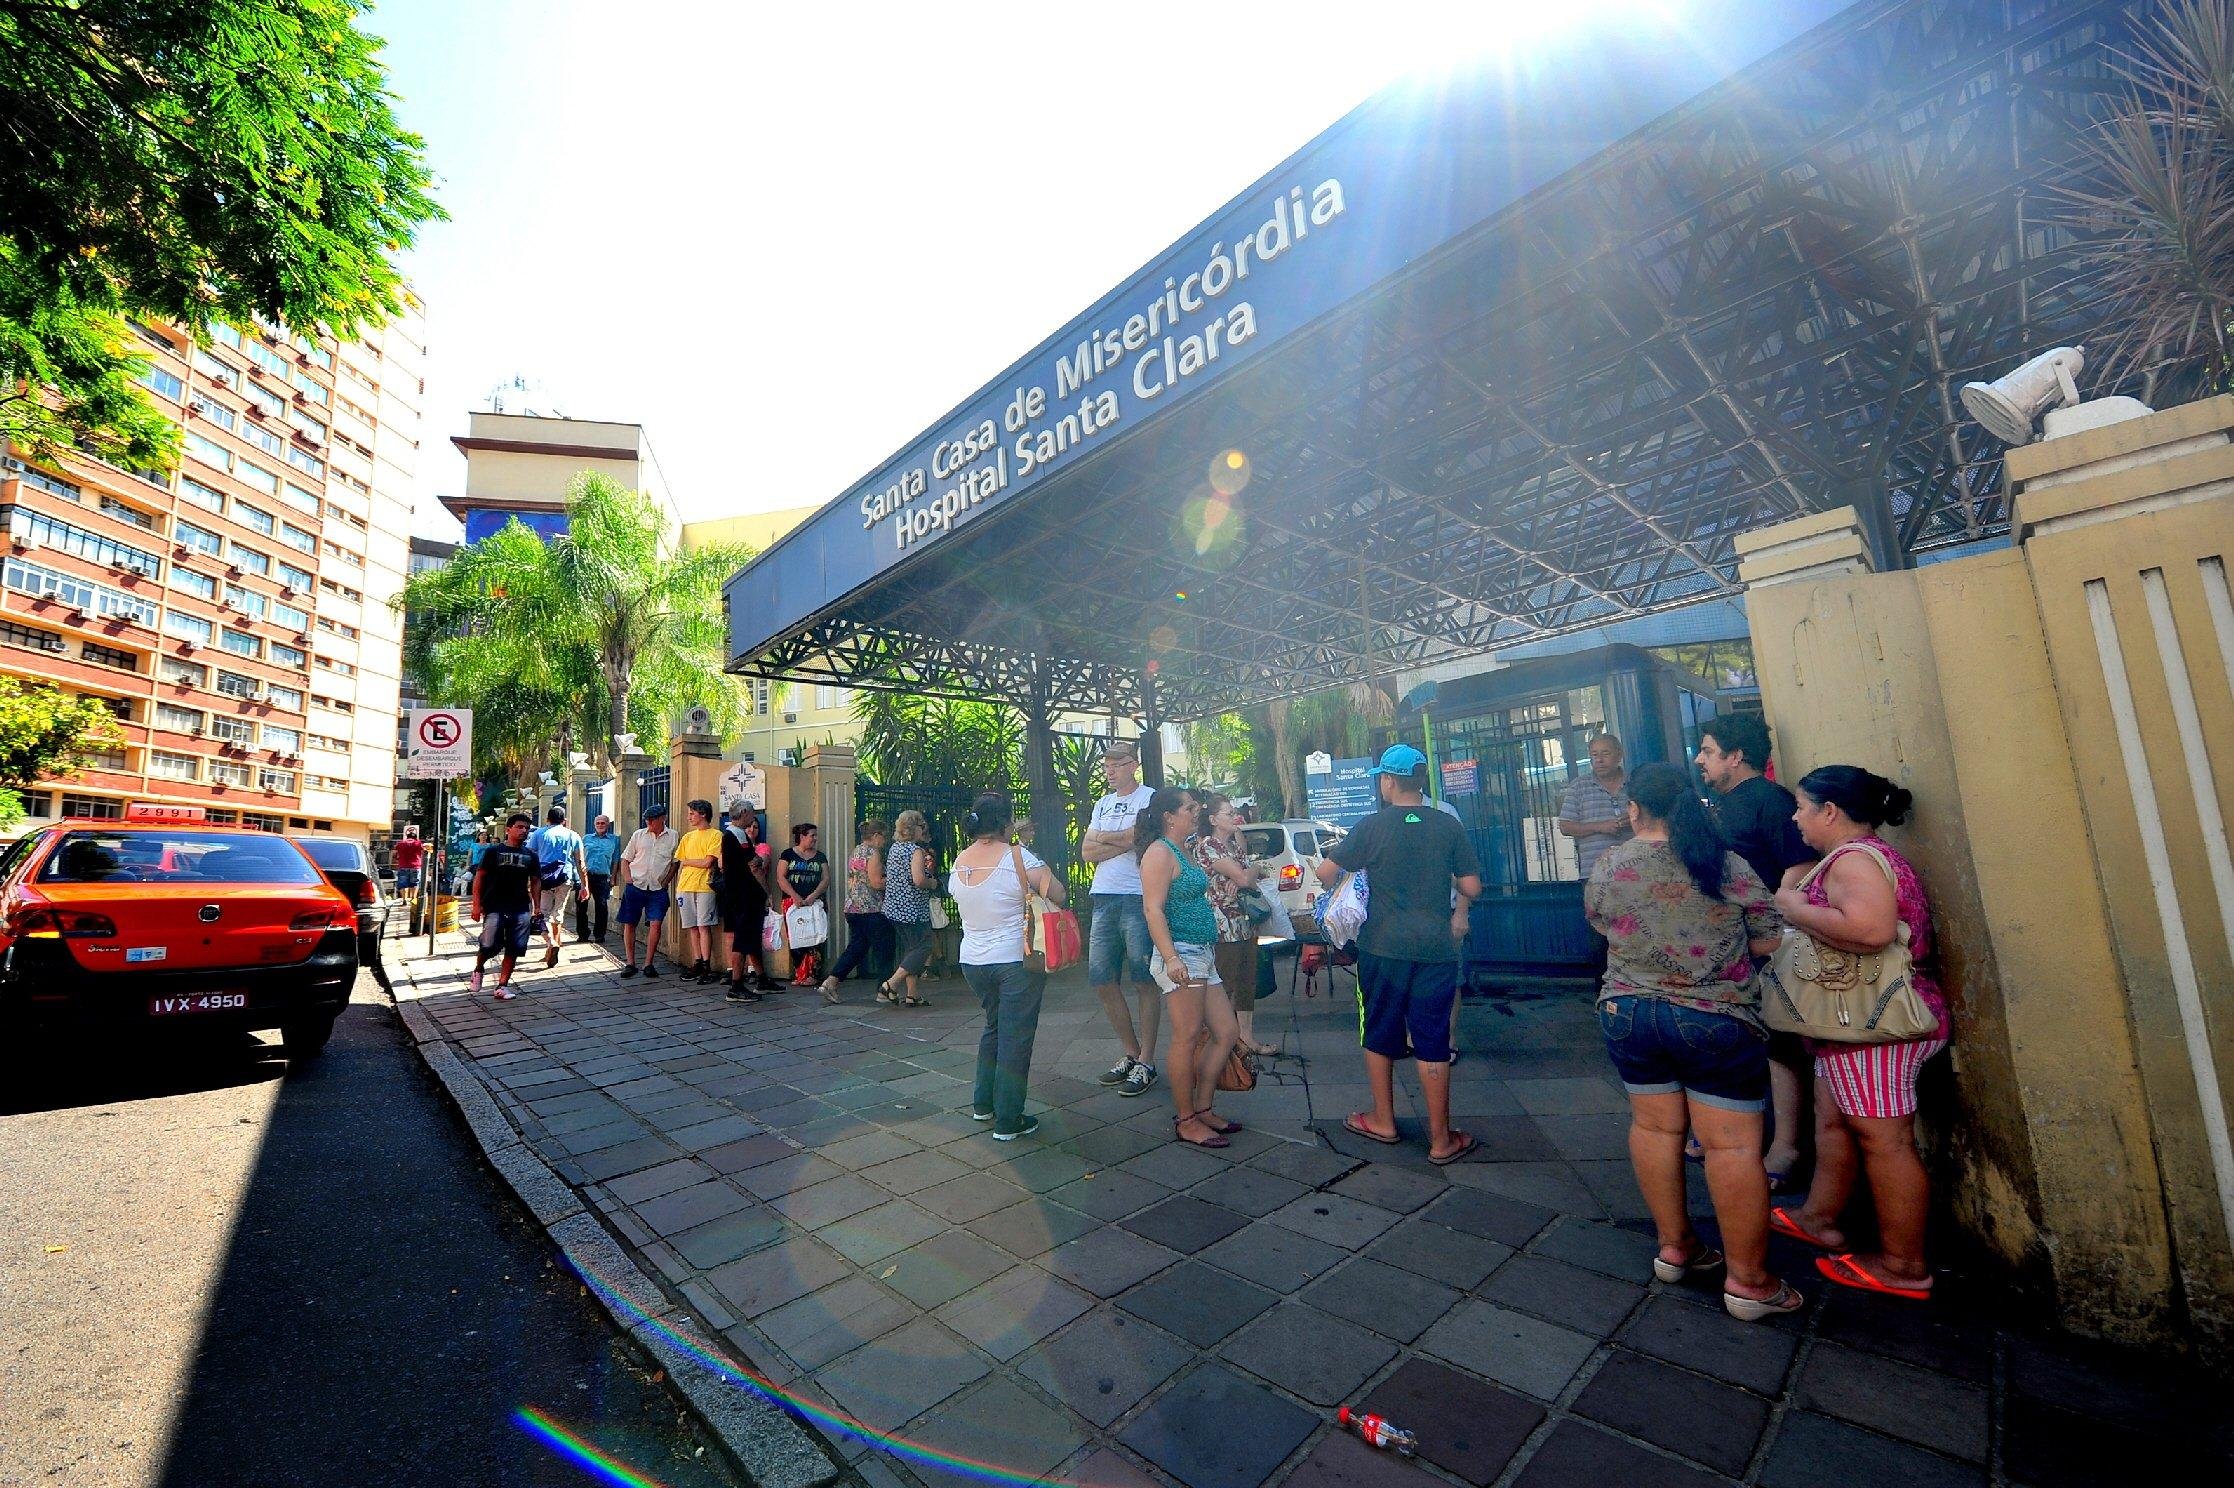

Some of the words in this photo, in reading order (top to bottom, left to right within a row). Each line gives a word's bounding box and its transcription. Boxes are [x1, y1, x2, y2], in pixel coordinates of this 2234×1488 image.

[860, 466, 928, 531] Santa
[931, 416, 997, 481] Casa
[1004, 385, 1046, 434] de
[1055, 175, 1348, 399] Misericórdia
[894, 446, 1008, 551] Hospital
[1015, 389, 1120, 477] Santa
[1131, 300, 1258, 400] Clara
[1340, 766, 1365, 774] Hospital
[139, 808, 192, 817] 2991
[154, 994, 246, 1012] IVX-4950
